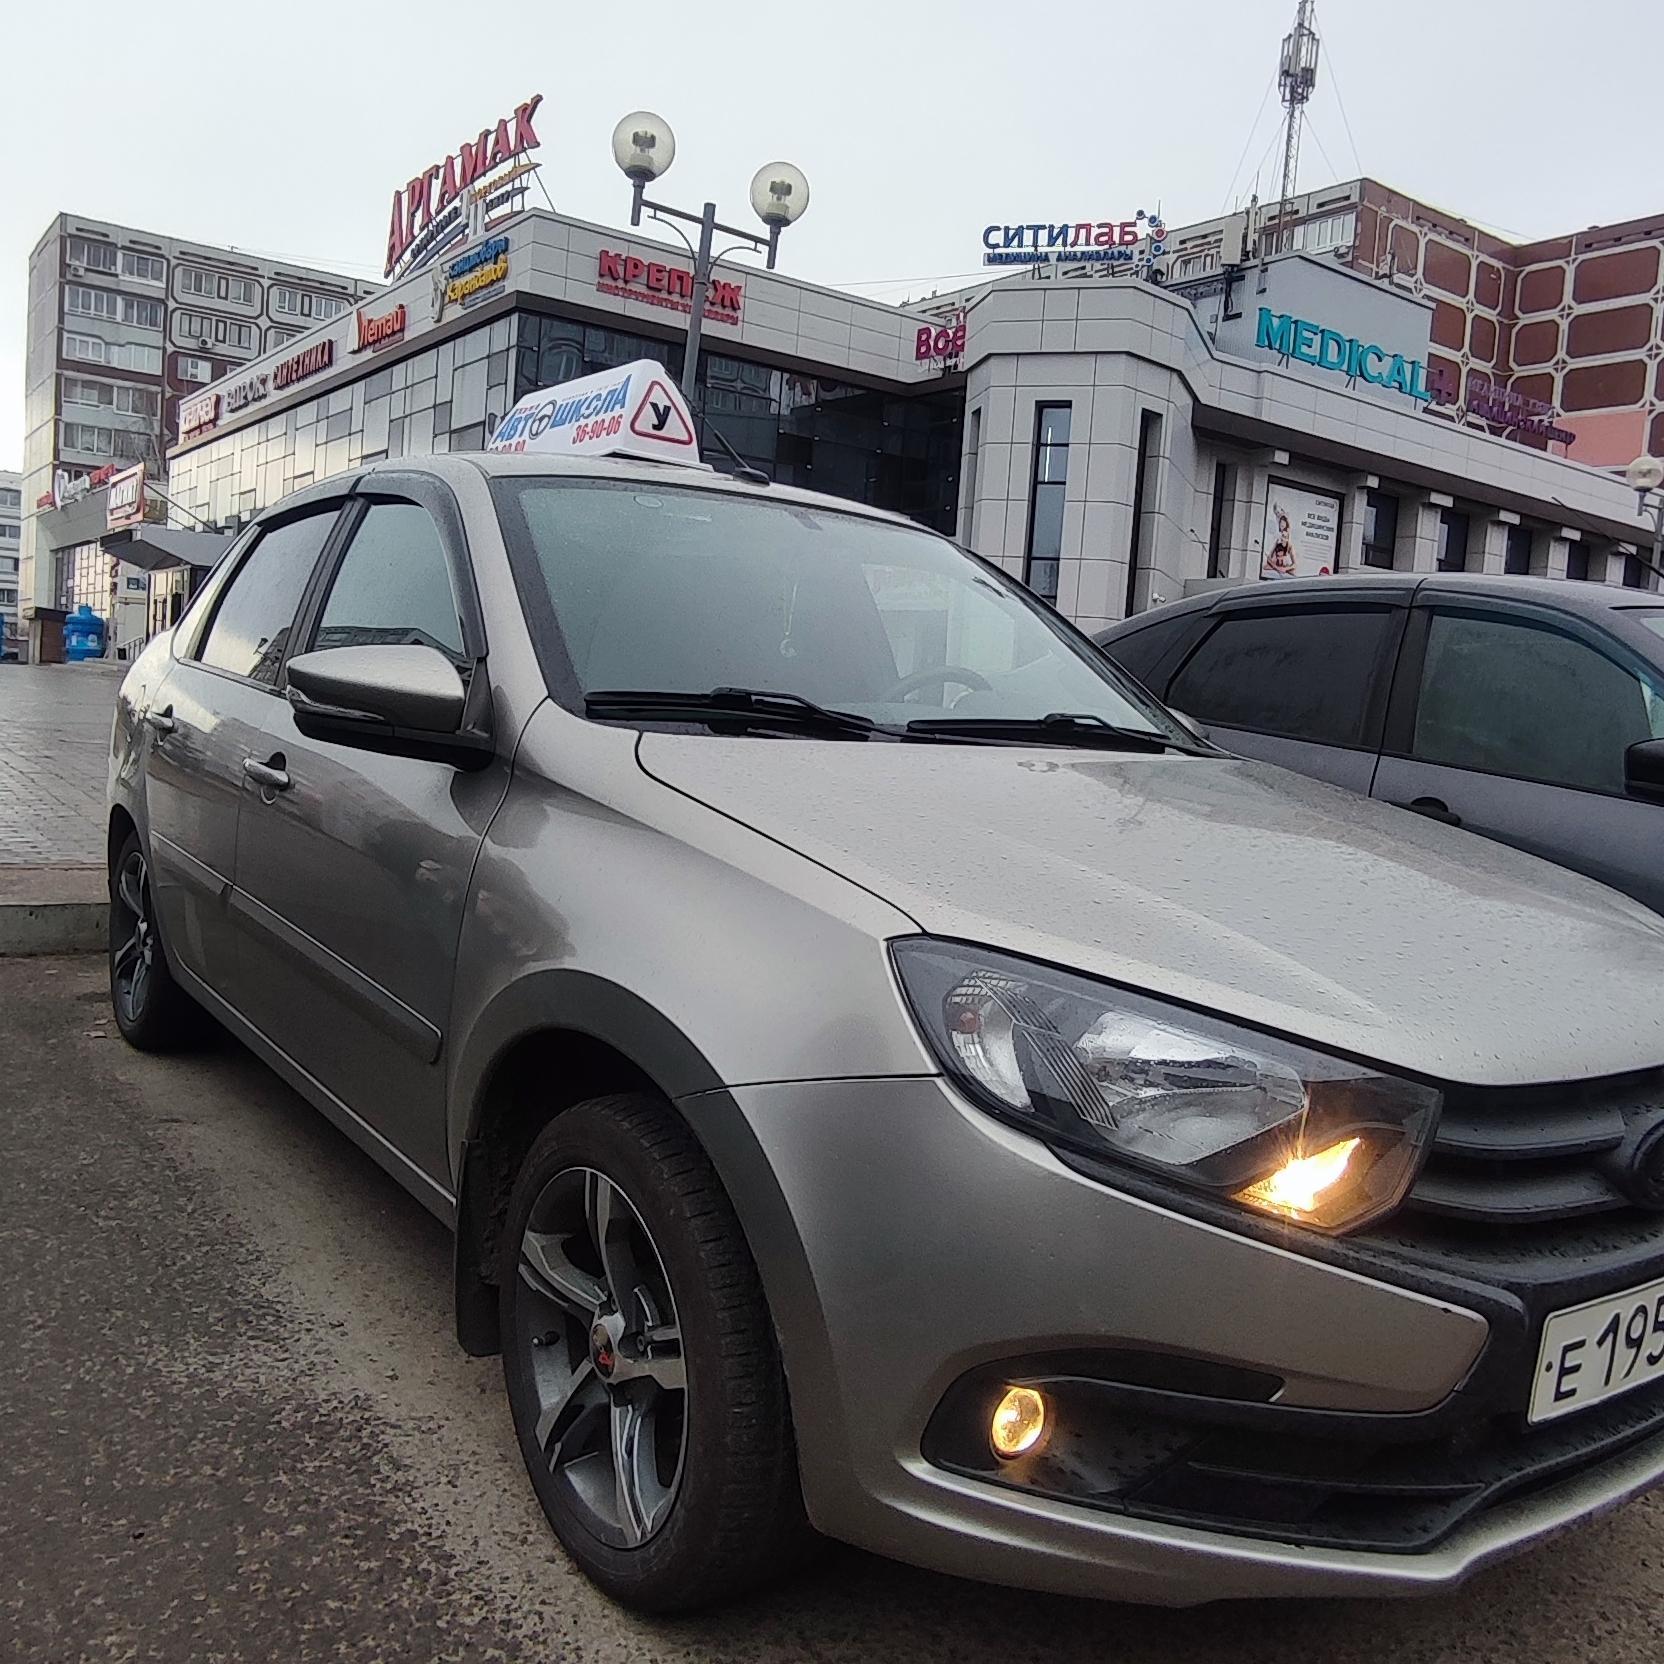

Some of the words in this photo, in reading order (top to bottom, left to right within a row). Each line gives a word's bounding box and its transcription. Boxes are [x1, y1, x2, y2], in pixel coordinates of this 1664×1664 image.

[384, 94, 543, 279] АРГАМАК
[599, 250, 742, 311] КРЕПЖ
[273, 339, 334, 390] САНТЕХНИКА
[1255, 307, 1431, 402] MEDICAL
[492, 373, 633, 444] АВТОШКОЛА
[572, 414, 623, 444] 36-90-06
[650, 402, 671, 431] У
